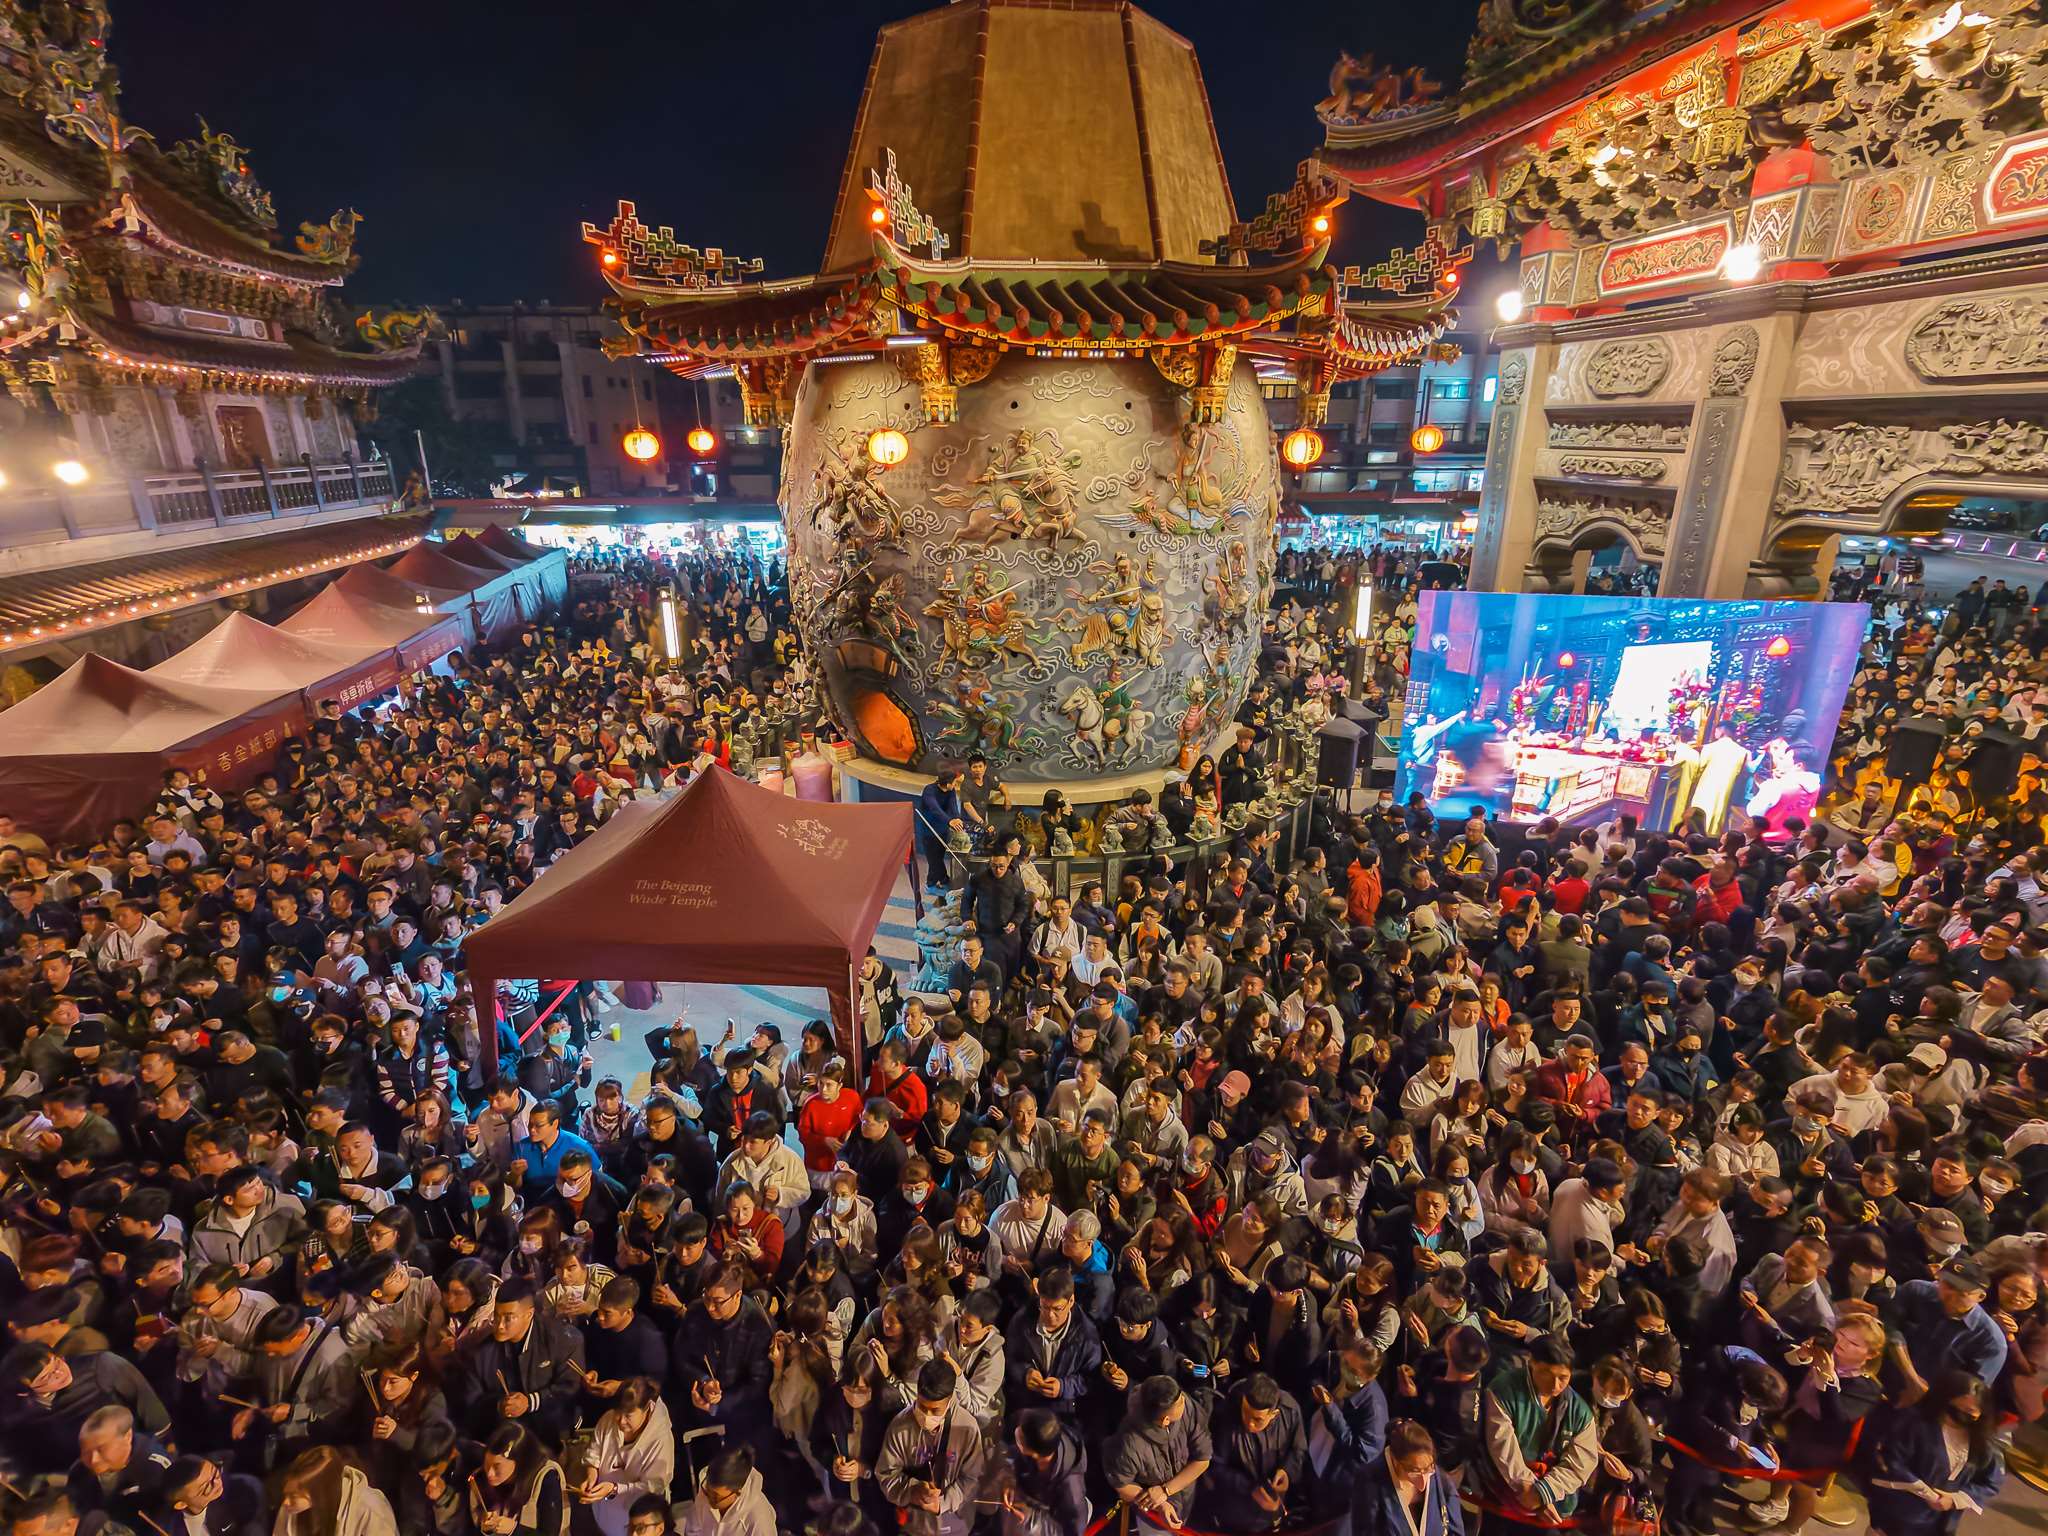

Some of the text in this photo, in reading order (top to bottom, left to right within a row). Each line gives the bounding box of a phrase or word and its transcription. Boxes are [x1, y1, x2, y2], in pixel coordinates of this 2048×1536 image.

[635, 879, 712, 895] The Beigang
[629, 893, 718, 909] Wude Temple
